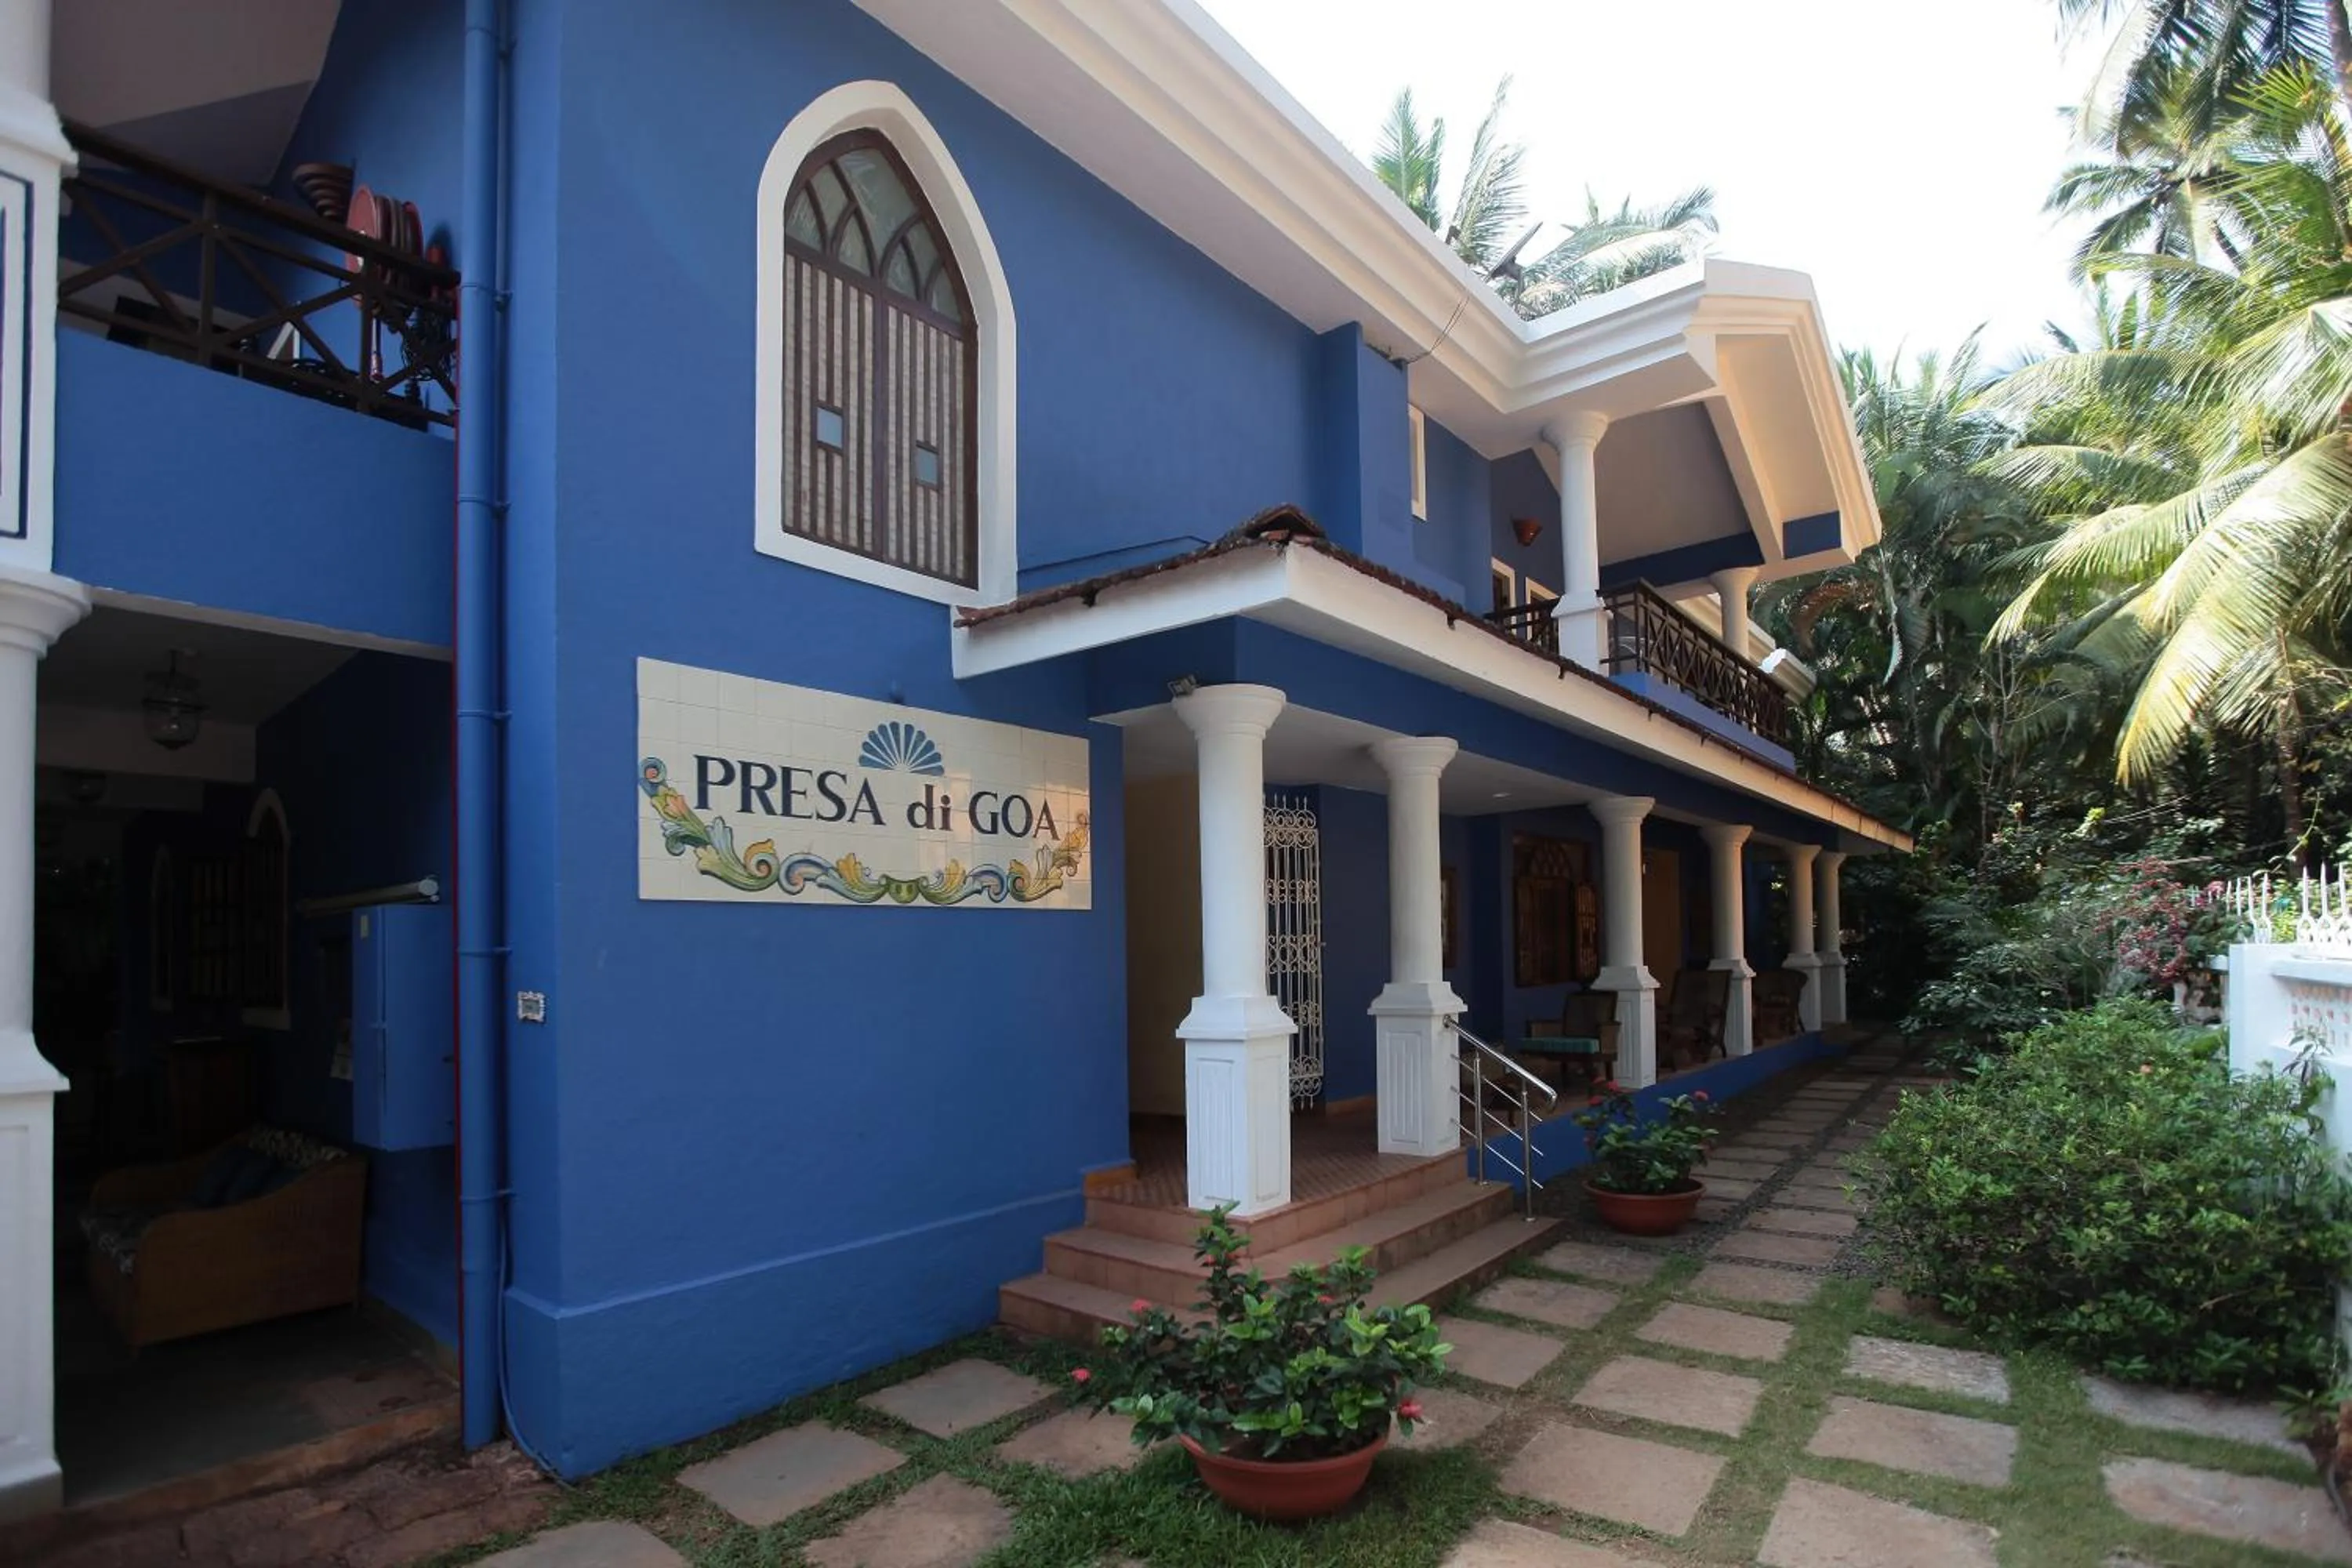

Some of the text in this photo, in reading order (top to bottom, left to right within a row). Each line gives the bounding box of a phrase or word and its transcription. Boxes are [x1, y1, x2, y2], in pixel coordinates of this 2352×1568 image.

[693, 754, 1059, 840] PRESA di GOA
